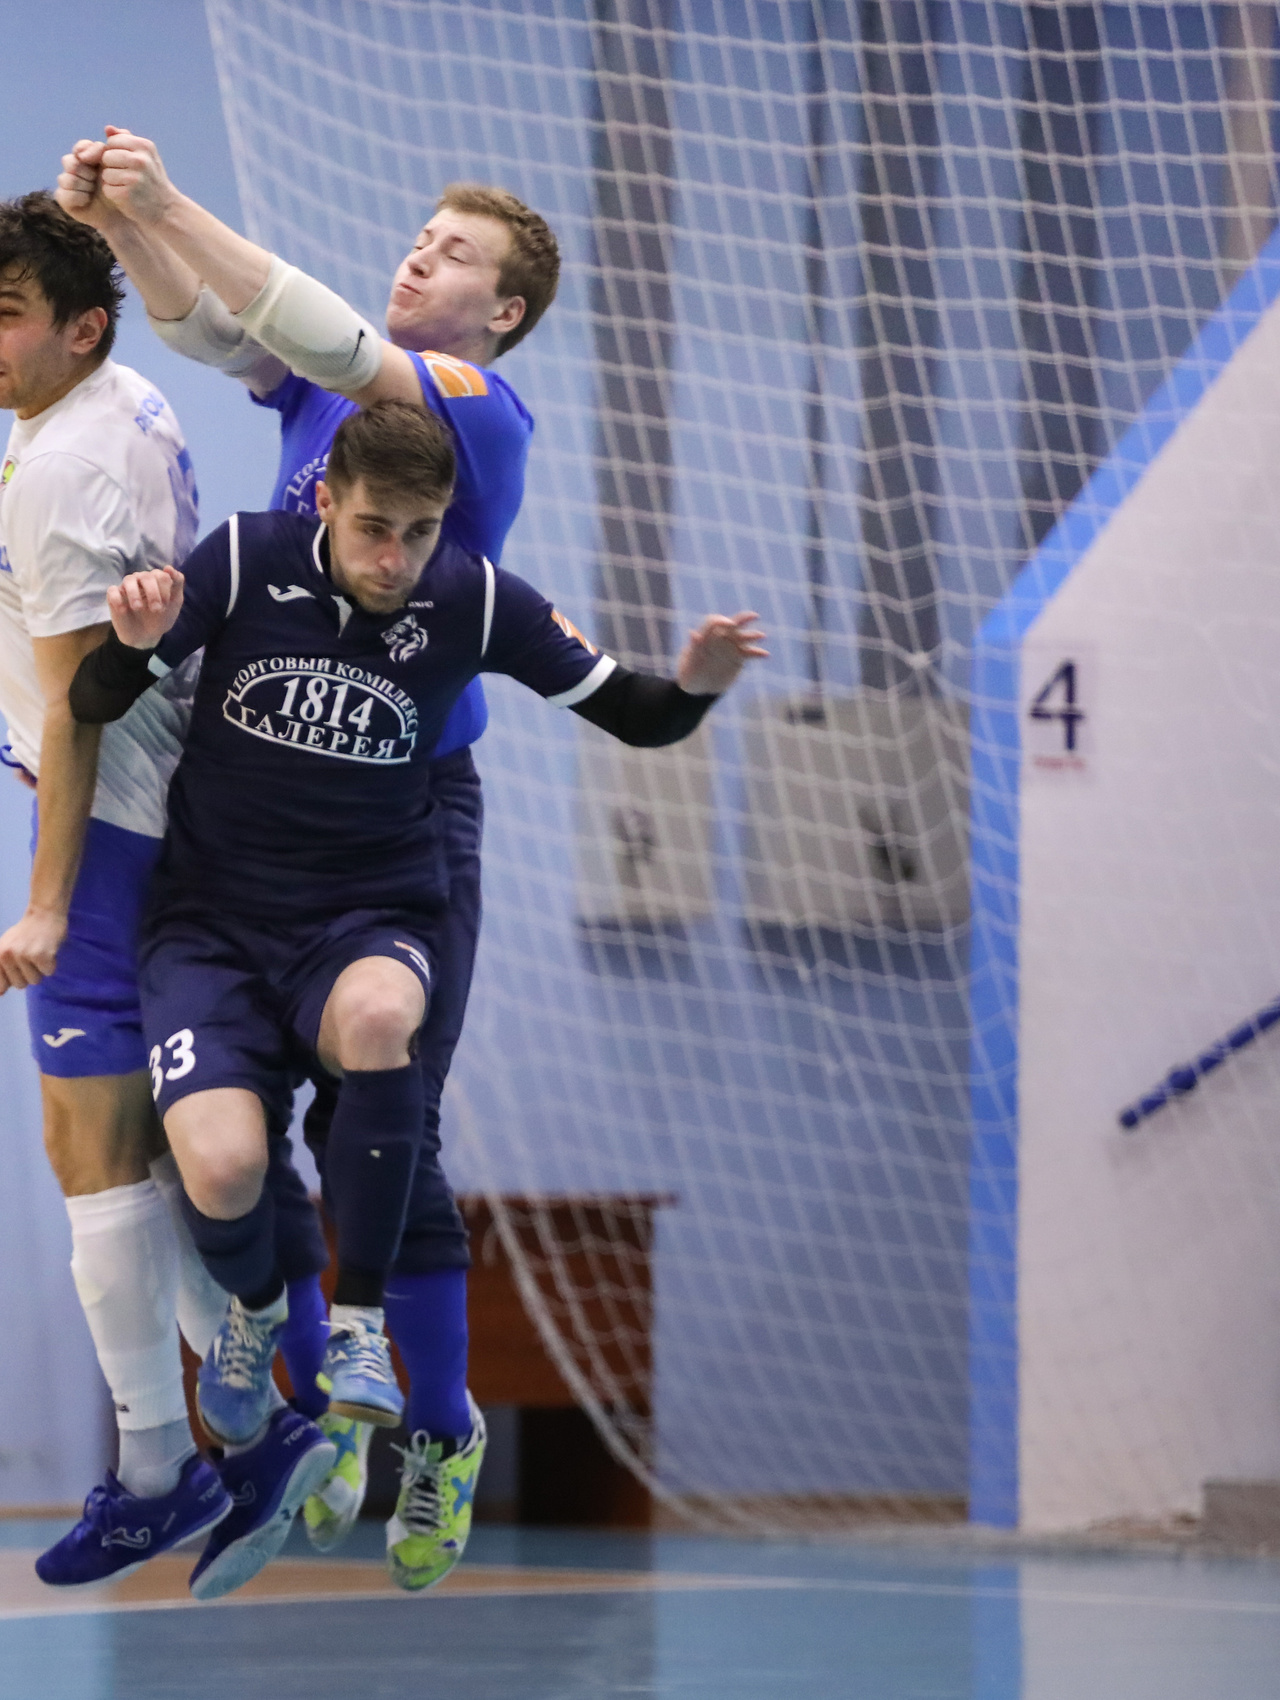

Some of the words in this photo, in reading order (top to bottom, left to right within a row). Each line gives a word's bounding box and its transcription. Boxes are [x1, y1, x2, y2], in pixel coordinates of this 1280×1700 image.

[232, 656, 332, 691] ТОРГОВЫЙ
[334, 661, 420, 732] КОМПЛЕКС
[276, 676, 374, 734] 1814
[1028, 660, 1086, 752] 4
[239, 704, 398, 759] ГАЛЕРЕЯ
[148, 1028, 196, 1102] 33
